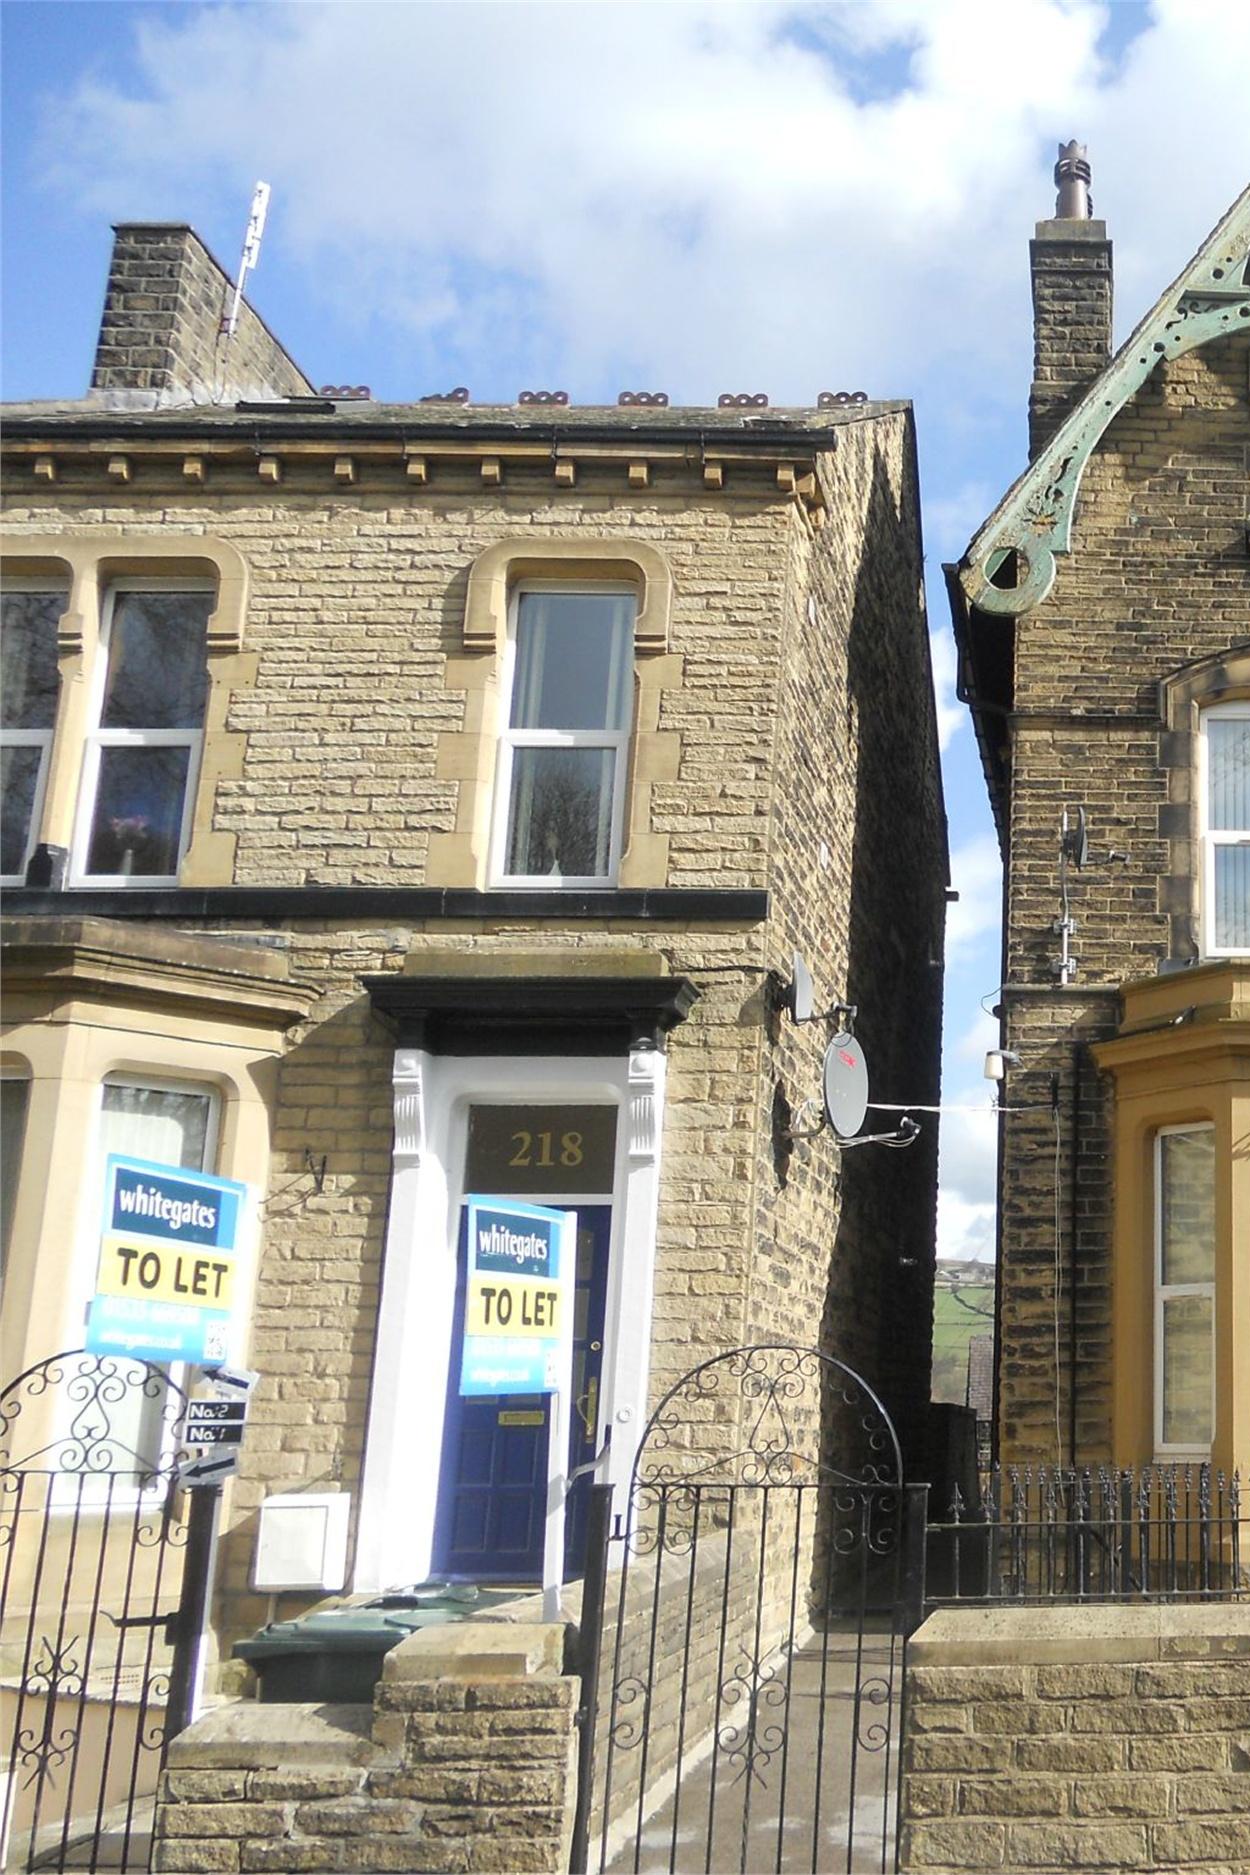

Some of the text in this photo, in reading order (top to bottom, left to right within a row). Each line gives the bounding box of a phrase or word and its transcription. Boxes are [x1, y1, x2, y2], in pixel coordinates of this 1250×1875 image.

[509, 1131, 583, 1167] 218
[119, 1184, 216, 1230] whitegates
[479, 1223, 548, 1264] whitegates
[117, 1247, 229, 1298] TO LET
[480, 1287, 558, 1327] TO LET
